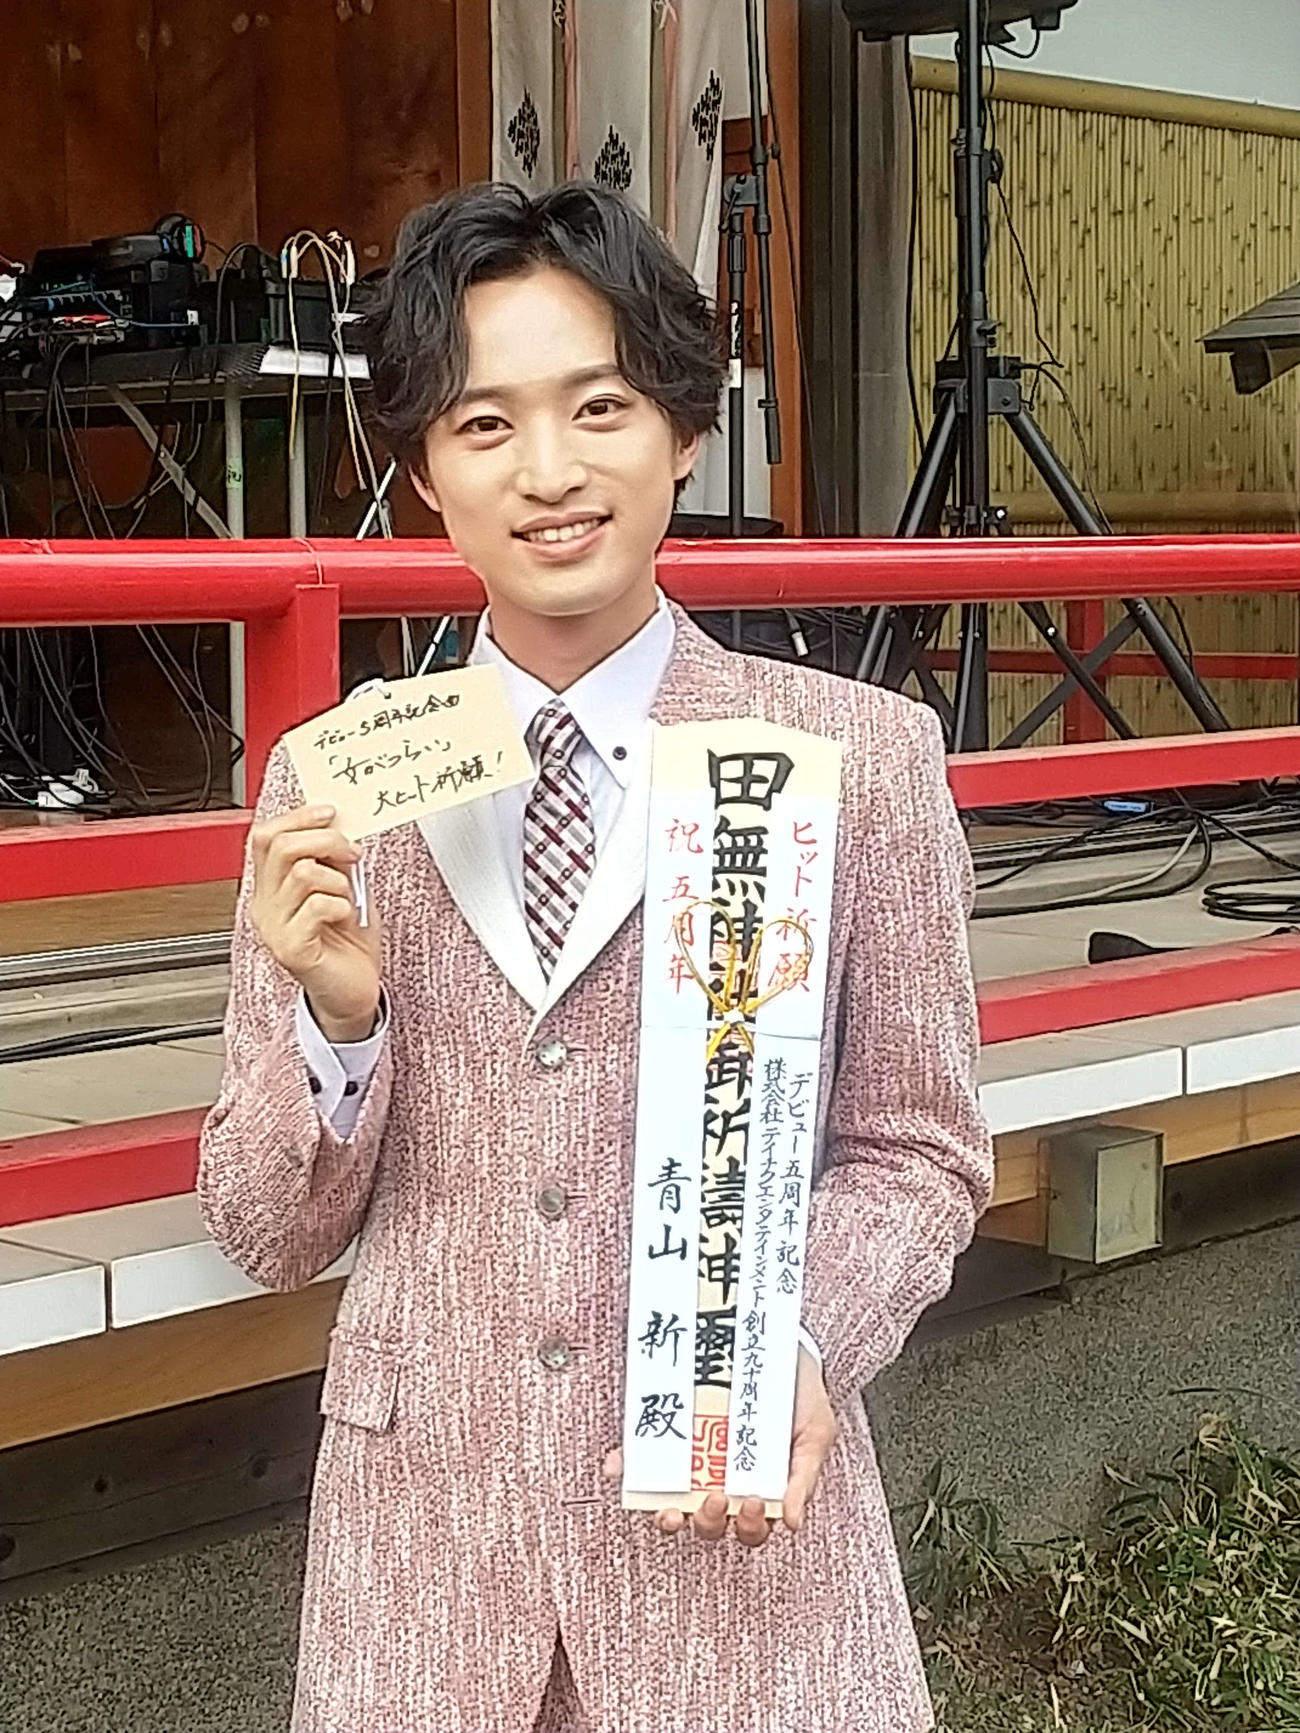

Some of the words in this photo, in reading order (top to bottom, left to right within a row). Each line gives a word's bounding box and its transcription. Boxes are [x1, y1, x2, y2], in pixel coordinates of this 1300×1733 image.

[776, 1072, 814, 1294] デビュー五周年記念
